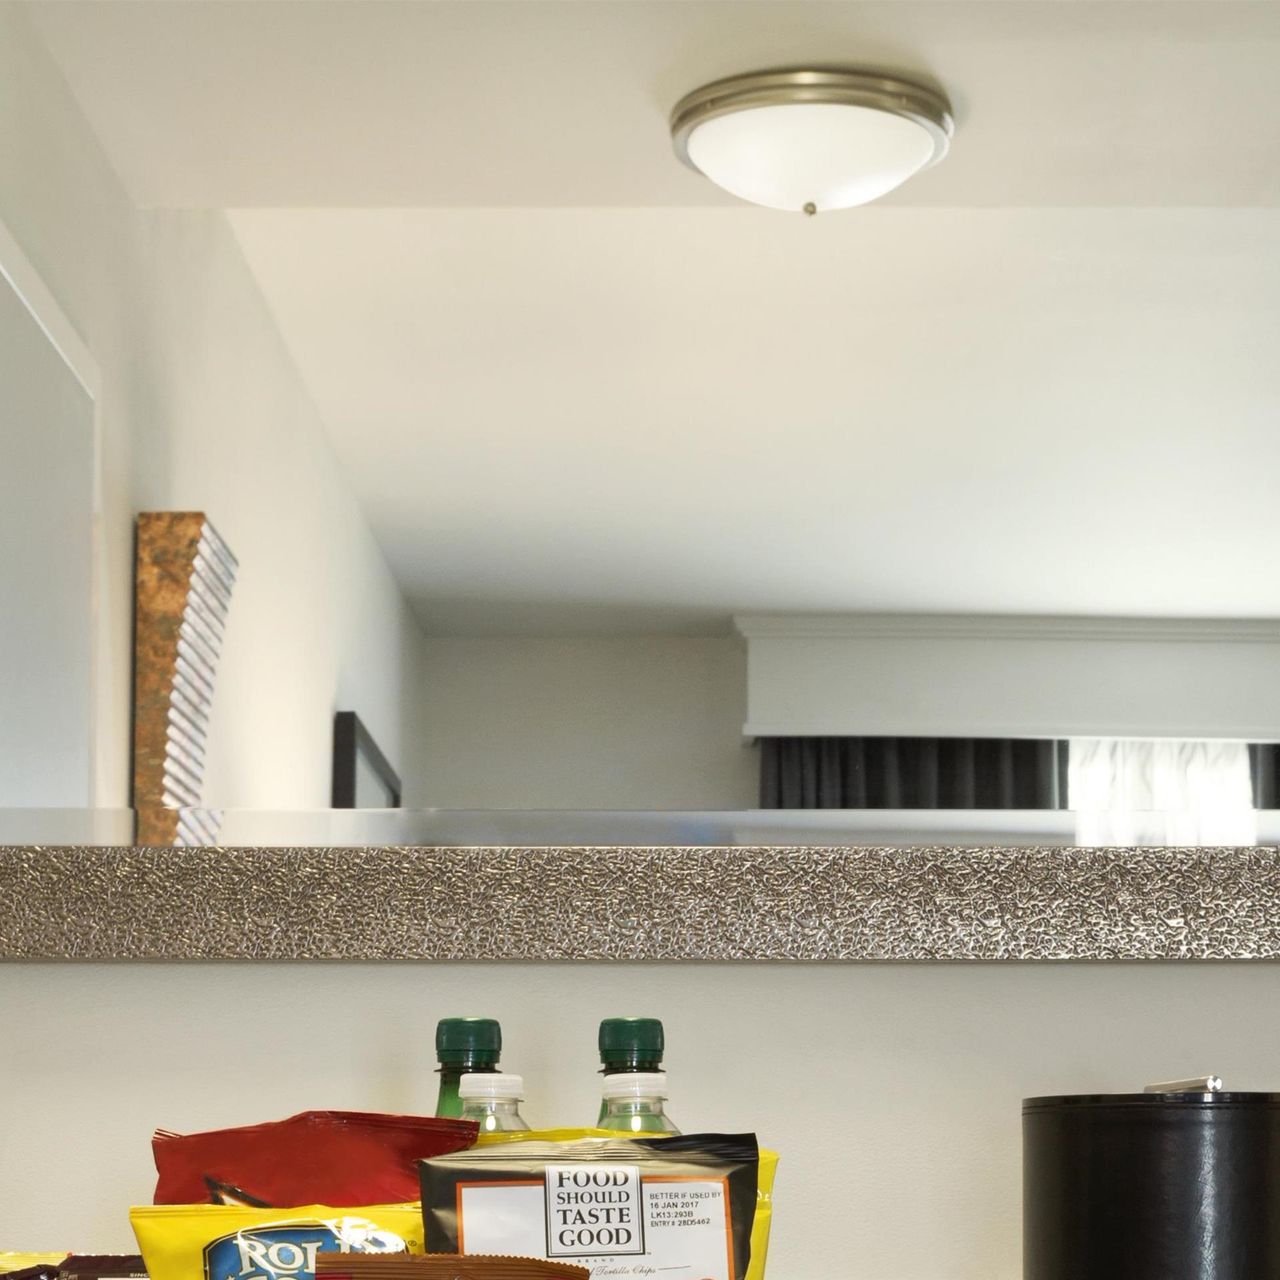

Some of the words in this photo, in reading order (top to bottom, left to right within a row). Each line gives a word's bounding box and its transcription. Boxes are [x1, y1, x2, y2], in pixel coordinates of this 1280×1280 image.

[557, 1171, 629, 1187] FOOD
[557, 1190, 630, 1205] SHOULD
[649, 1192, 679, 1200] BETTER
[661, 1201, 678, 1209] JAN
[557, 1207, 631, 1225] TASTE
[558, 1228, 632, 1247] GOOD
[595, 1265, 630, 1276] Tortilla
[632, 1263, 657, 1277] Chips
